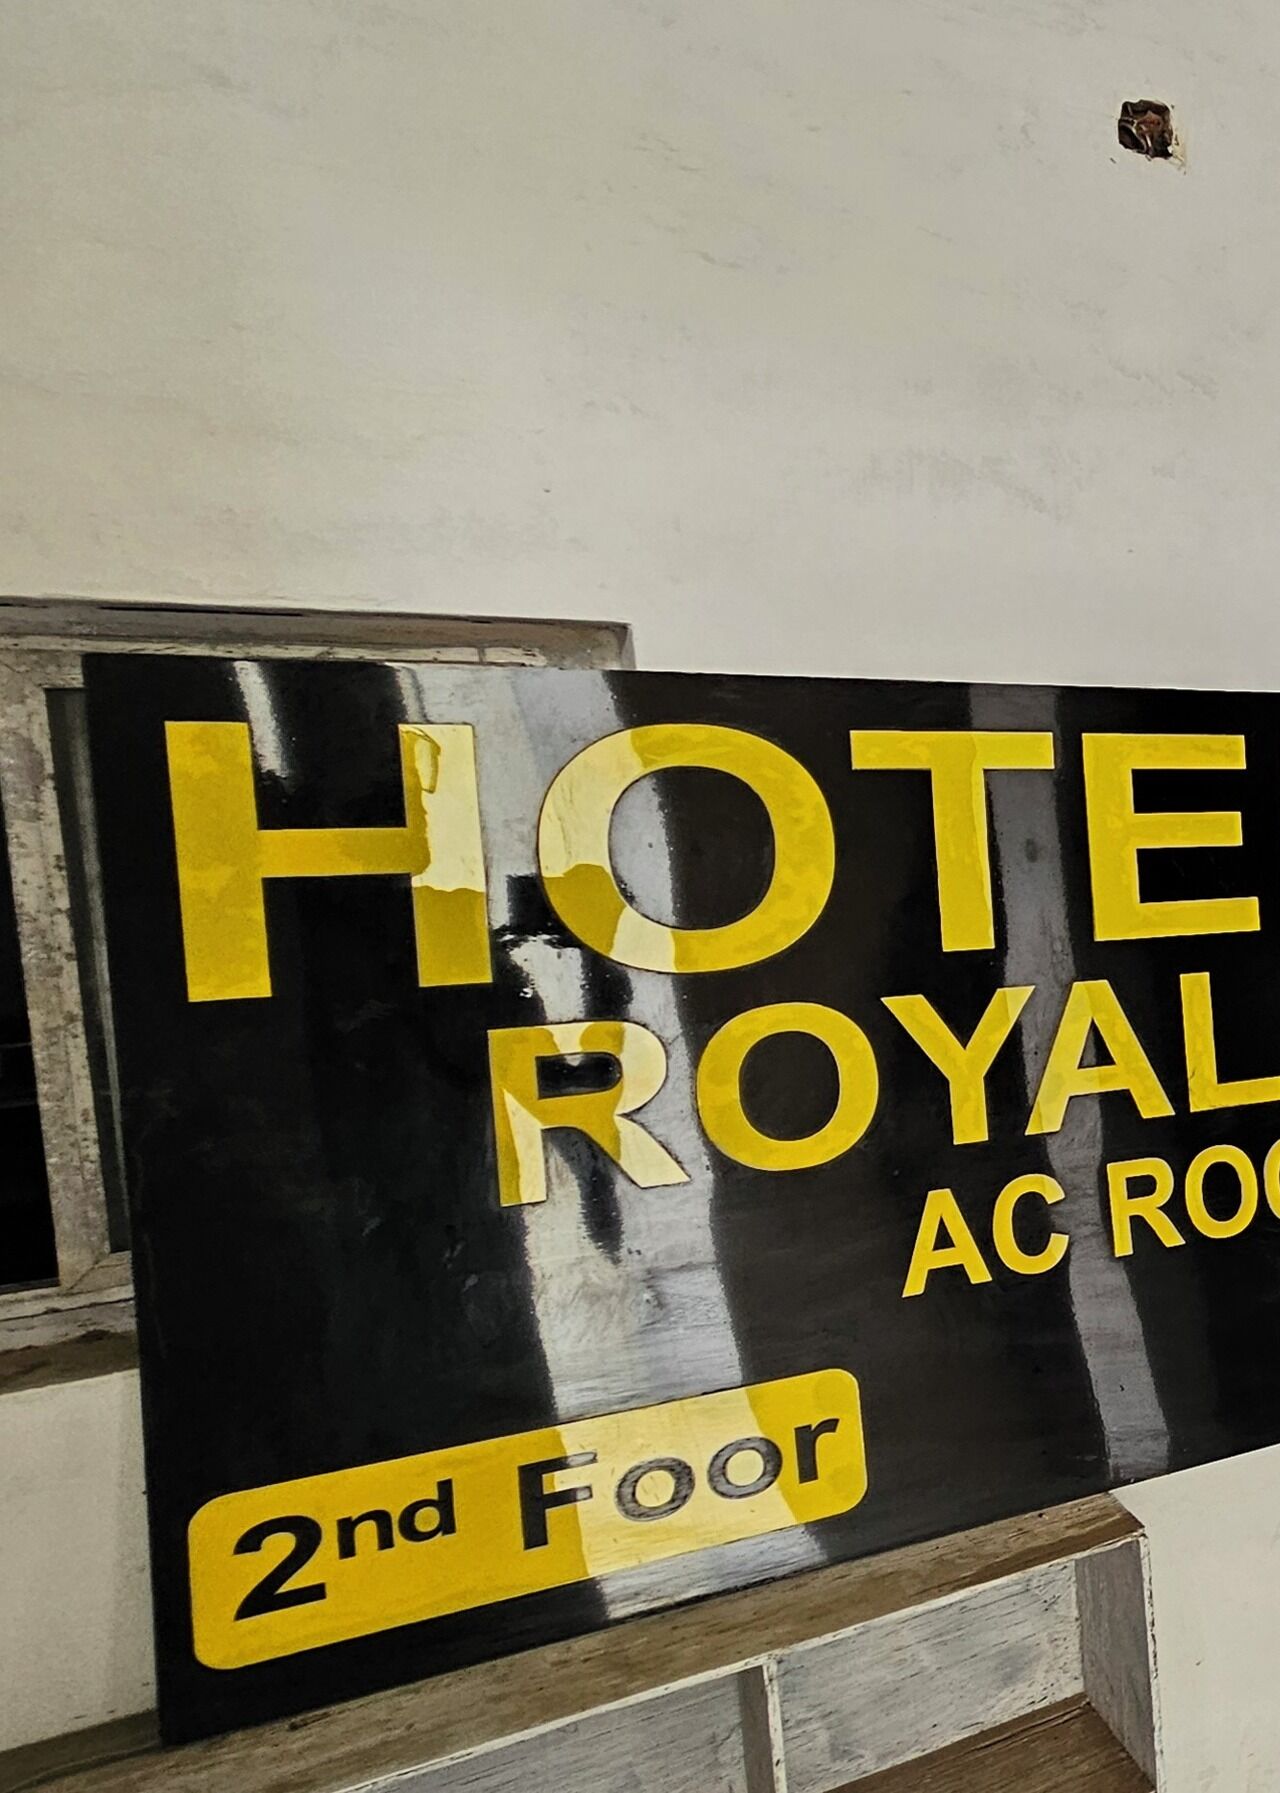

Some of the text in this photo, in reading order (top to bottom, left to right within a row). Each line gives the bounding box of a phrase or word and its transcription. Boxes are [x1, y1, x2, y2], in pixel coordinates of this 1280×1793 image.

[902, 1172, 1070, 1298] AC
[232, 1416, 840, 1622] 2nd Foor
